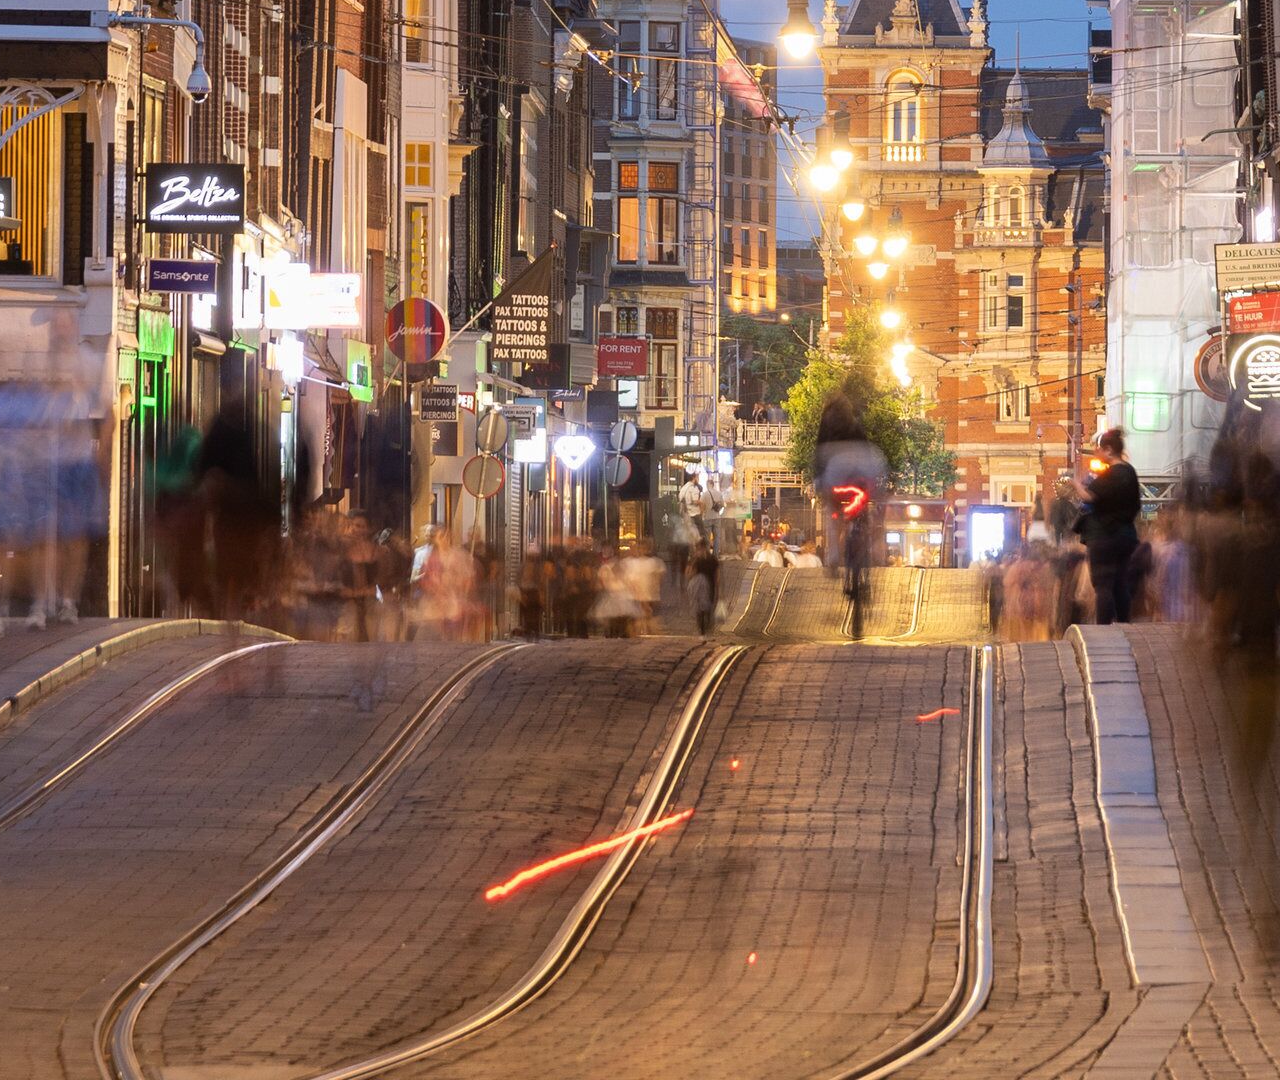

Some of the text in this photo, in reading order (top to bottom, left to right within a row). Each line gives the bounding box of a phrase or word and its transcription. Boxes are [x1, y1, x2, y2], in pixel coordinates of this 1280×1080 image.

[153, 270, 209, 281] Samsonite
[511, 294, 549, 306] TATTOOS
[495, 306, 549, 317] PAX TATTOOS
[1234, 312, 1264, 322] TE HUUR
[495, 320, 547, 332] TATTOOS &
[389, 322, 442, 342] jamin
[496, 334, 546, 346] PIERCINGS
[493, 348, 547, 360] PAX TATTOOS
[600, 344, 642, 354] FOR RENT
[422, 398, 456, 407] TATTOOS &
[422, 411, 456, 420] PIERCINGS
